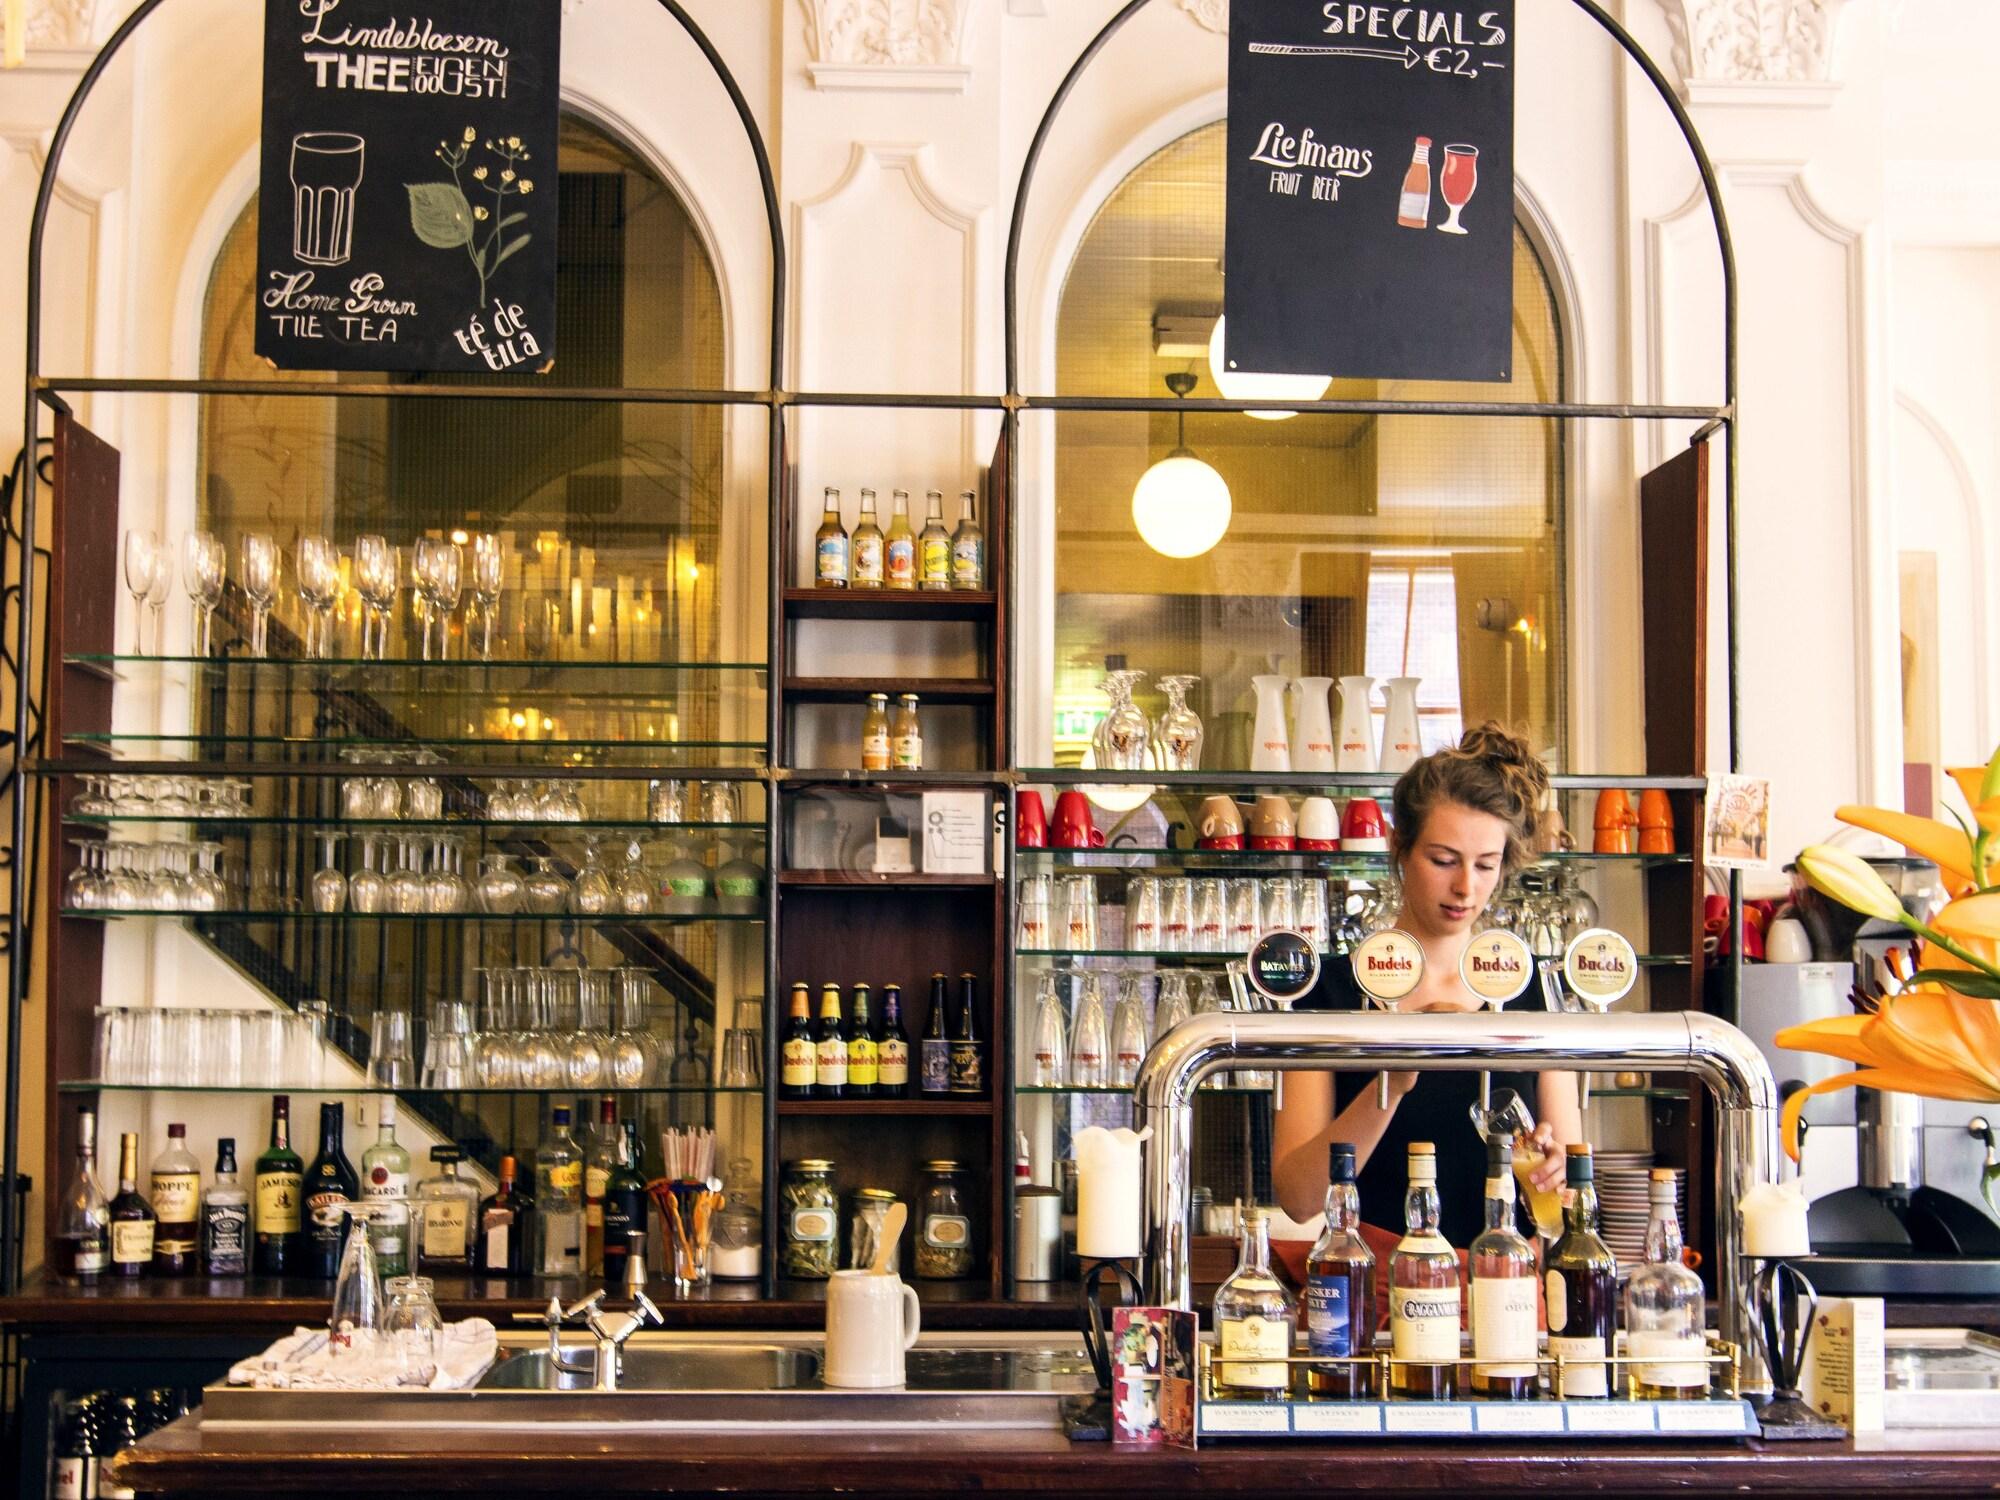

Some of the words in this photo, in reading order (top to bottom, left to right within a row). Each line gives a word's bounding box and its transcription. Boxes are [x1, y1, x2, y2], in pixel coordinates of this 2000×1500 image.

[1323, 3, 1506, 46] SPECIALS
[304, 52, 411, 93] THEE
[1249, 122, 1373, 178] Liefmans
[1269, 171, 1303, 197] FRUIT
[1312, 175, 1340, 201] BEER
[263, 270, 342, 312] Home
[345, 272, 419, 316] Grown
[270, 315, 324, 338] TILE
[338, 316, 398, 343] TEA
[453, 313, 490, 355] té
[494, 298, 528, 337] de
[1368, 956, 1412, 971] Budels
